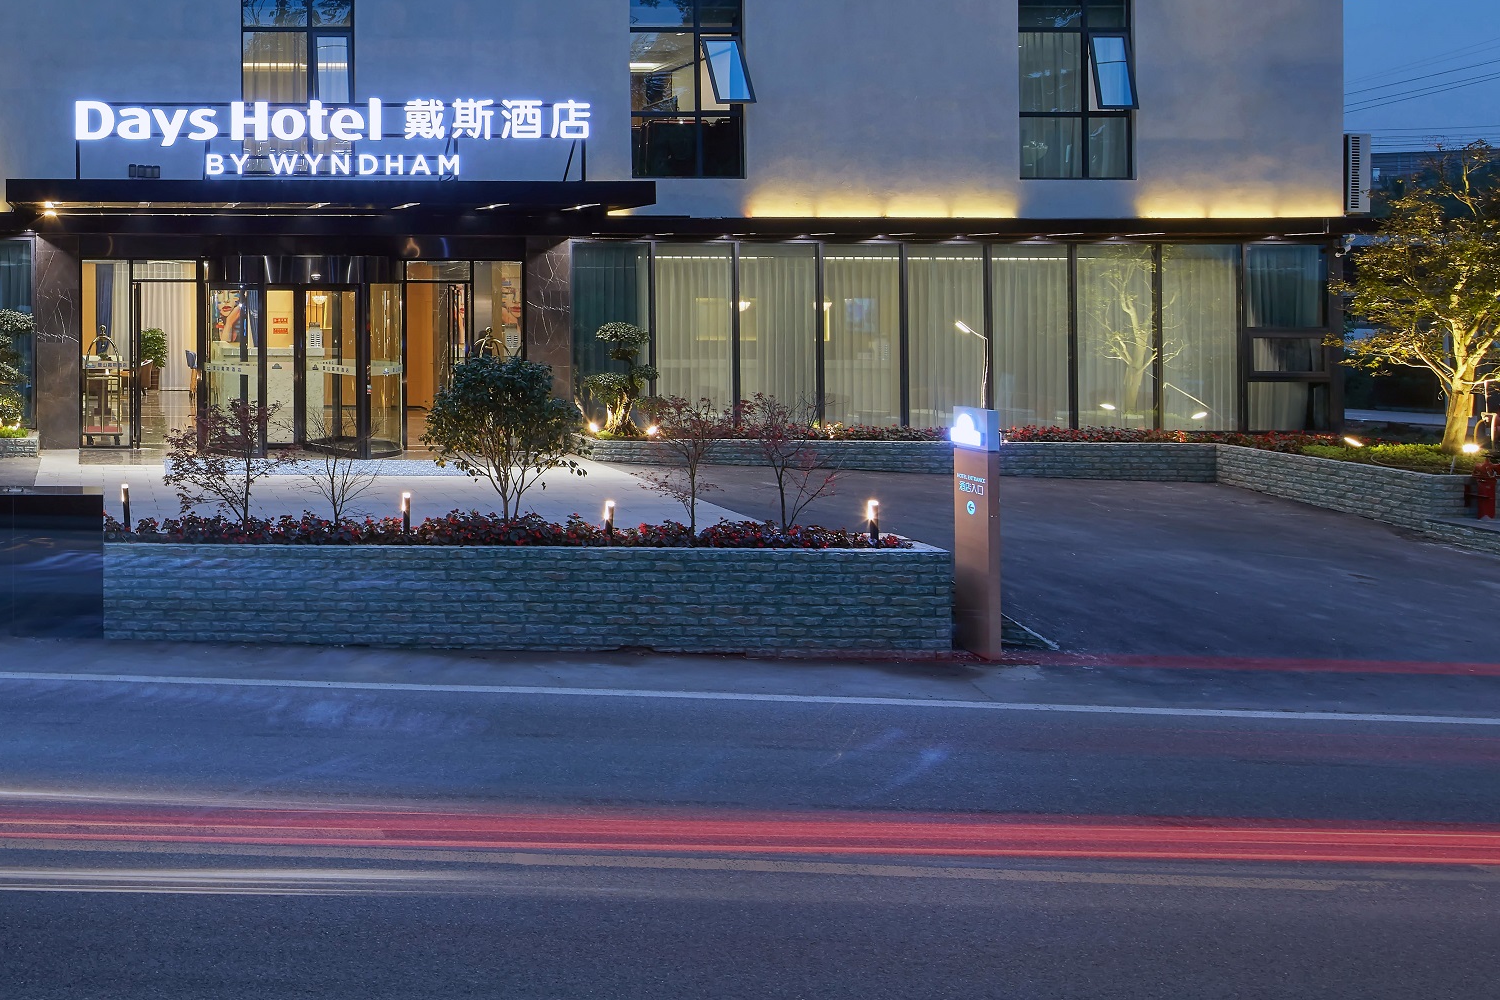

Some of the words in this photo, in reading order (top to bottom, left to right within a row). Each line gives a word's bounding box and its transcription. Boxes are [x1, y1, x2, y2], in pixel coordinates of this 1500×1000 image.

[75, 100, 219, 147] Days
[231, 97, 382, 141] Hotel
[403, 98, 591, 140] 戴斯酒店
[206, 153, 250, 175] BY
[268, 153, 460, 176] WYNDHAM
[958, 480, 984, 496] 酒店入口
